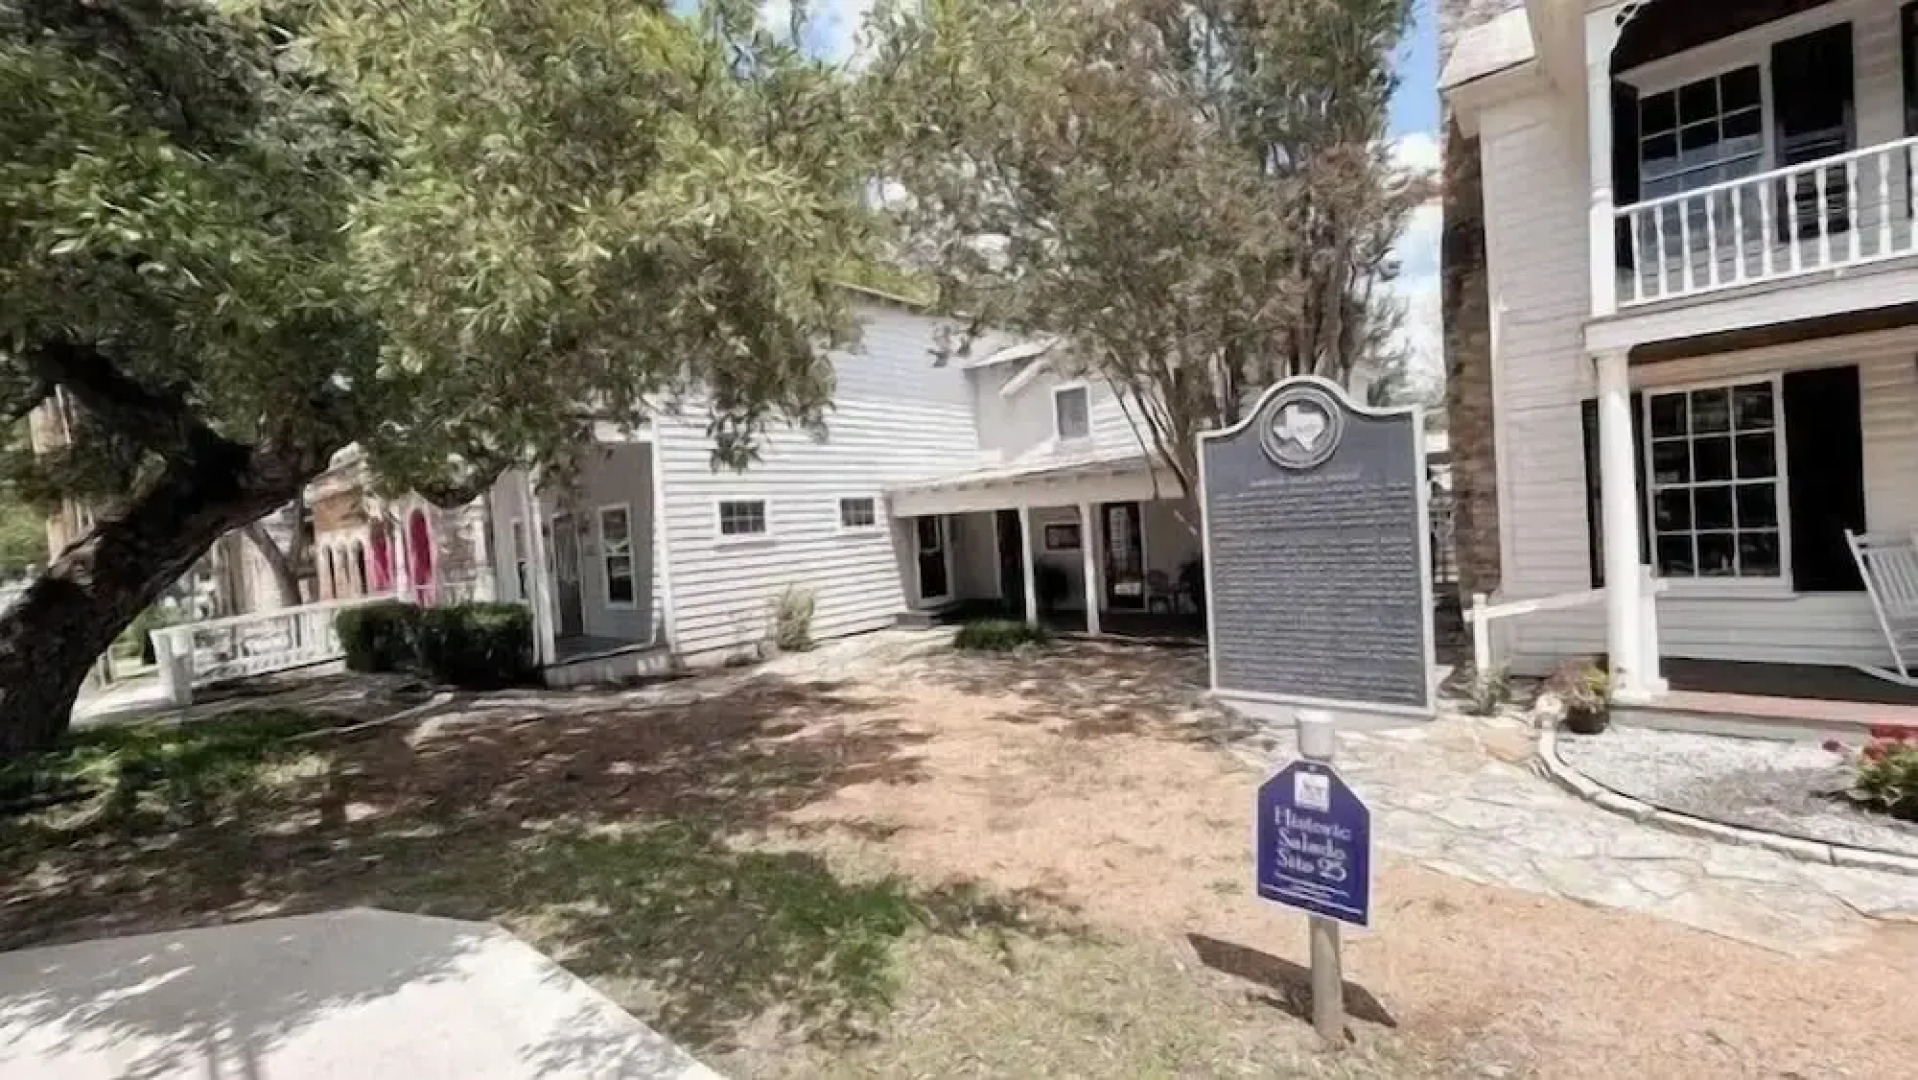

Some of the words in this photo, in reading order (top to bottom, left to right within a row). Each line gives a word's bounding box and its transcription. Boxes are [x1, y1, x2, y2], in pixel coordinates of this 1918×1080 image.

[1274, 805, 1351, 840] Historic
[1276, 827, 1347, 859] Salado
[1276, 847, 1315, 873] Site
